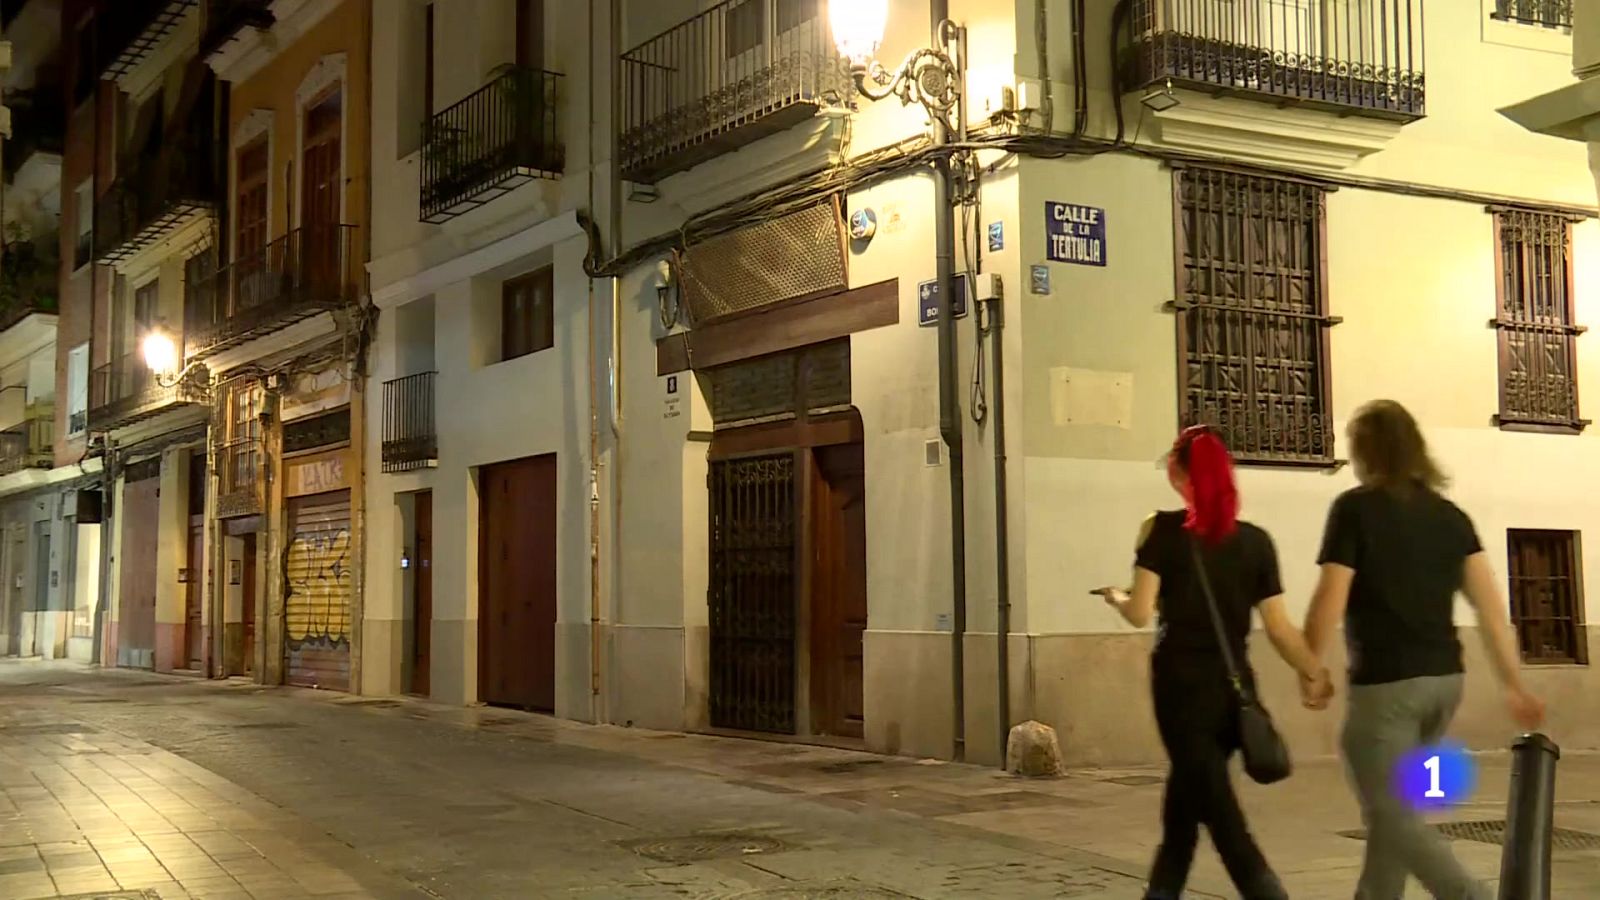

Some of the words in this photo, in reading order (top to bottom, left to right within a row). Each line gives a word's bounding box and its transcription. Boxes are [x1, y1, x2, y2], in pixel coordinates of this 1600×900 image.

[1054, 205, 1098, 225] CALLE
[1063, 222, 1073, 234] DE
[1079, 224, 1090, 235] LA
[1052, 234, 1100, 262] TERTULIA
